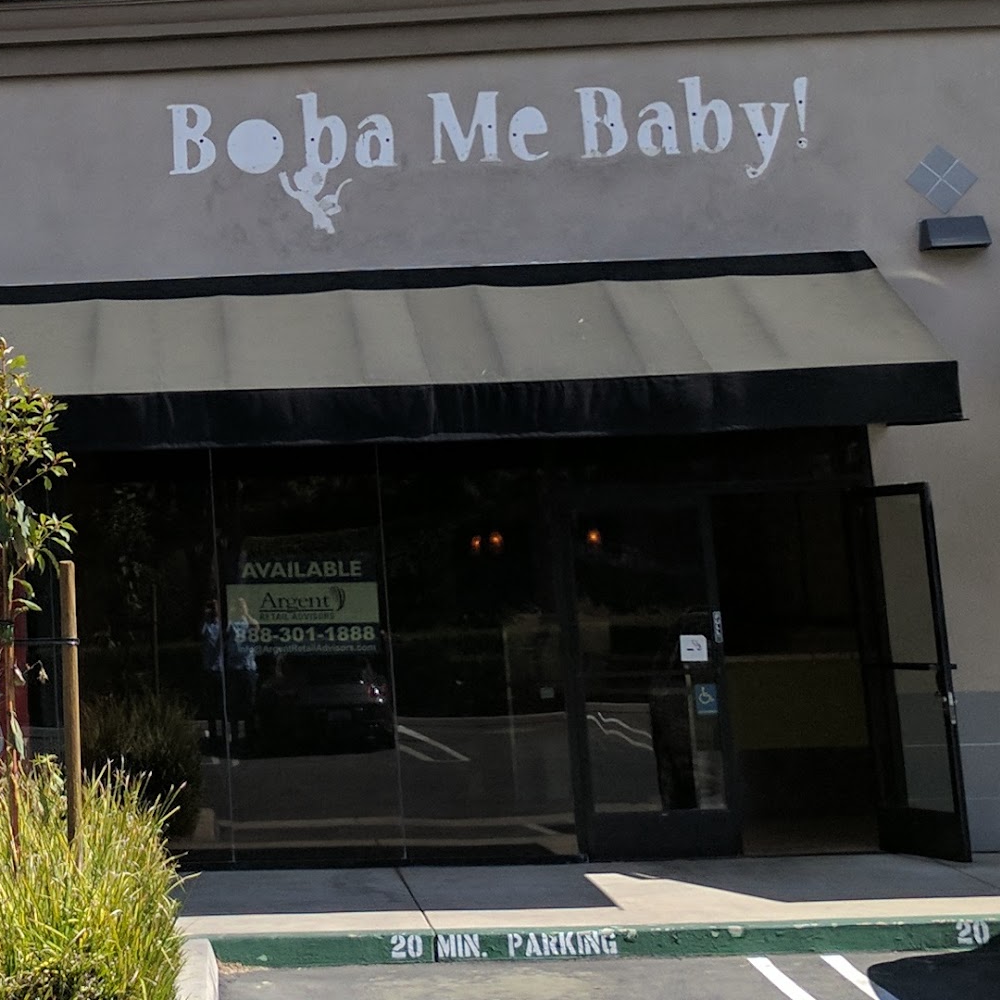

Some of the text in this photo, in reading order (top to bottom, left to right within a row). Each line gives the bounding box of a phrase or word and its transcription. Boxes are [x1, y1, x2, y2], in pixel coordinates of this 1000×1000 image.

[166, 75, 809, 179] Boba Me Baby!
[241, 560, 362, 579] AVAILABLE
[260, 592, 330, 610] Argent
[390, 930, 618, 959] 20 MIN. PARKING
[955, 919, 990, 945] 20
